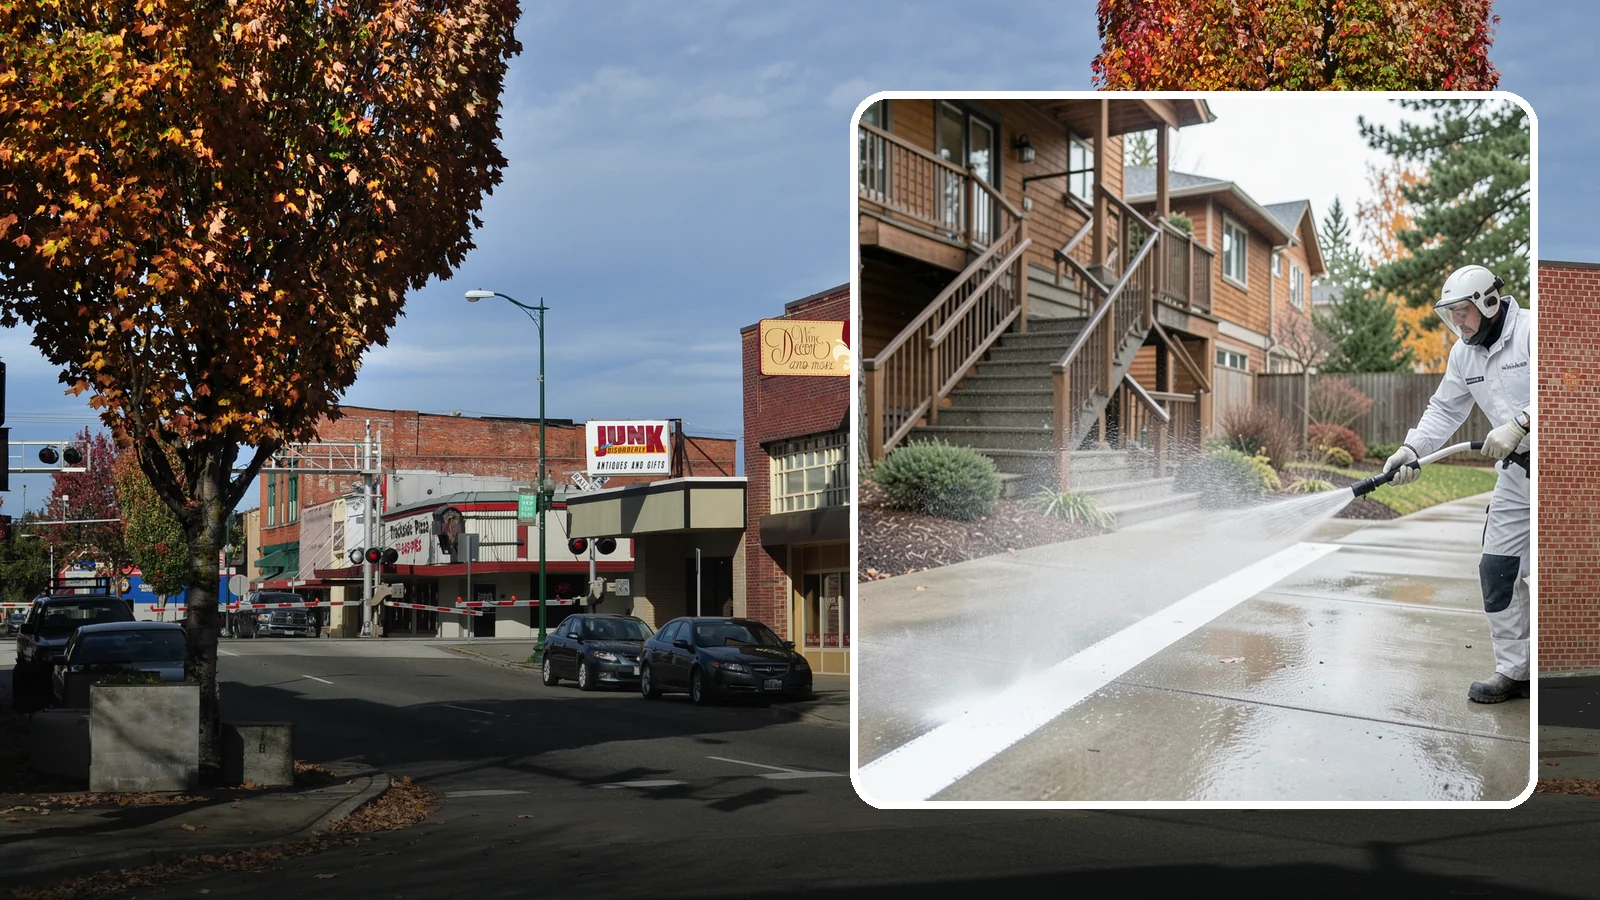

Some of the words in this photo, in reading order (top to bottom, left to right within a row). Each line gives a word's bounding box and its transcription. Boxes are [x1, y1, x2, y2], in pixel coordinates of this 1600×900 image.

[595, 425, 665, 457] JUNK
[597, 461, 628, 470] ANTIQUES
[631, 461, 643, 470] AND
[647, 461, 665, 470] GIFTS
[390, 521, 413, 540] Trackside
[414, 519, 429, 535] Pizza
